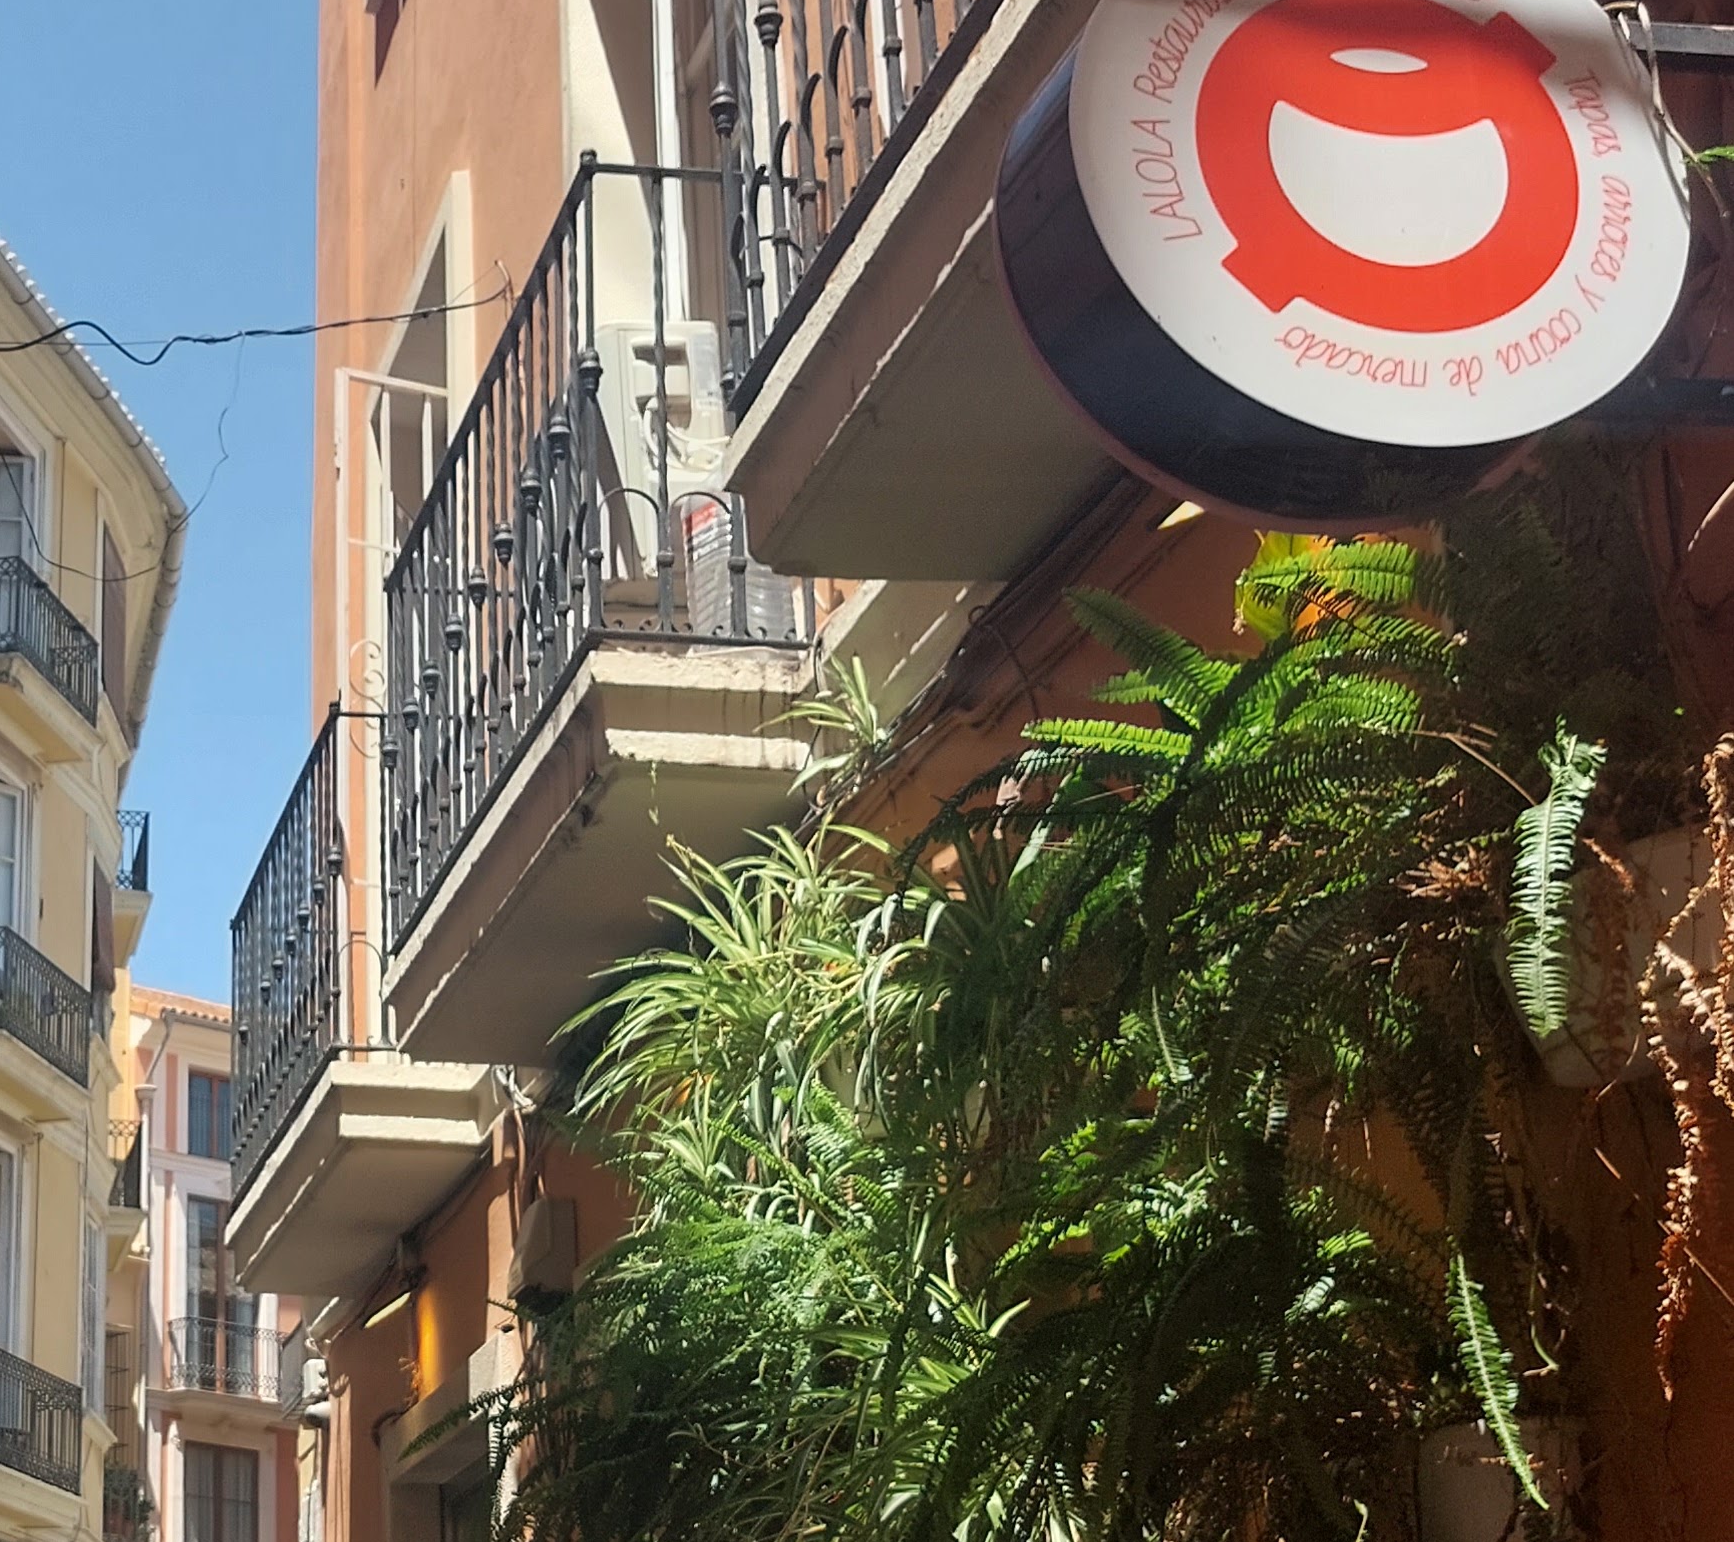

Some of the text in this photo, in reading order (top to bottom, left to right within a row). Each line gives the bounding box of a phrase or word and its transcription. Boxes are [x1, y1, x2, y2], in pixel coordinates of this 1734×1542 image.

[1131, 119, 1202, 241] LALOLA
[1592, 175, 1632, 283] arroces
[1575, 274, 1598, 314] y
[1273, 326, 1429, 388] mercado
[1496, 309, 1583, 374] cocina
[1442, 356, 1484, 397] de
